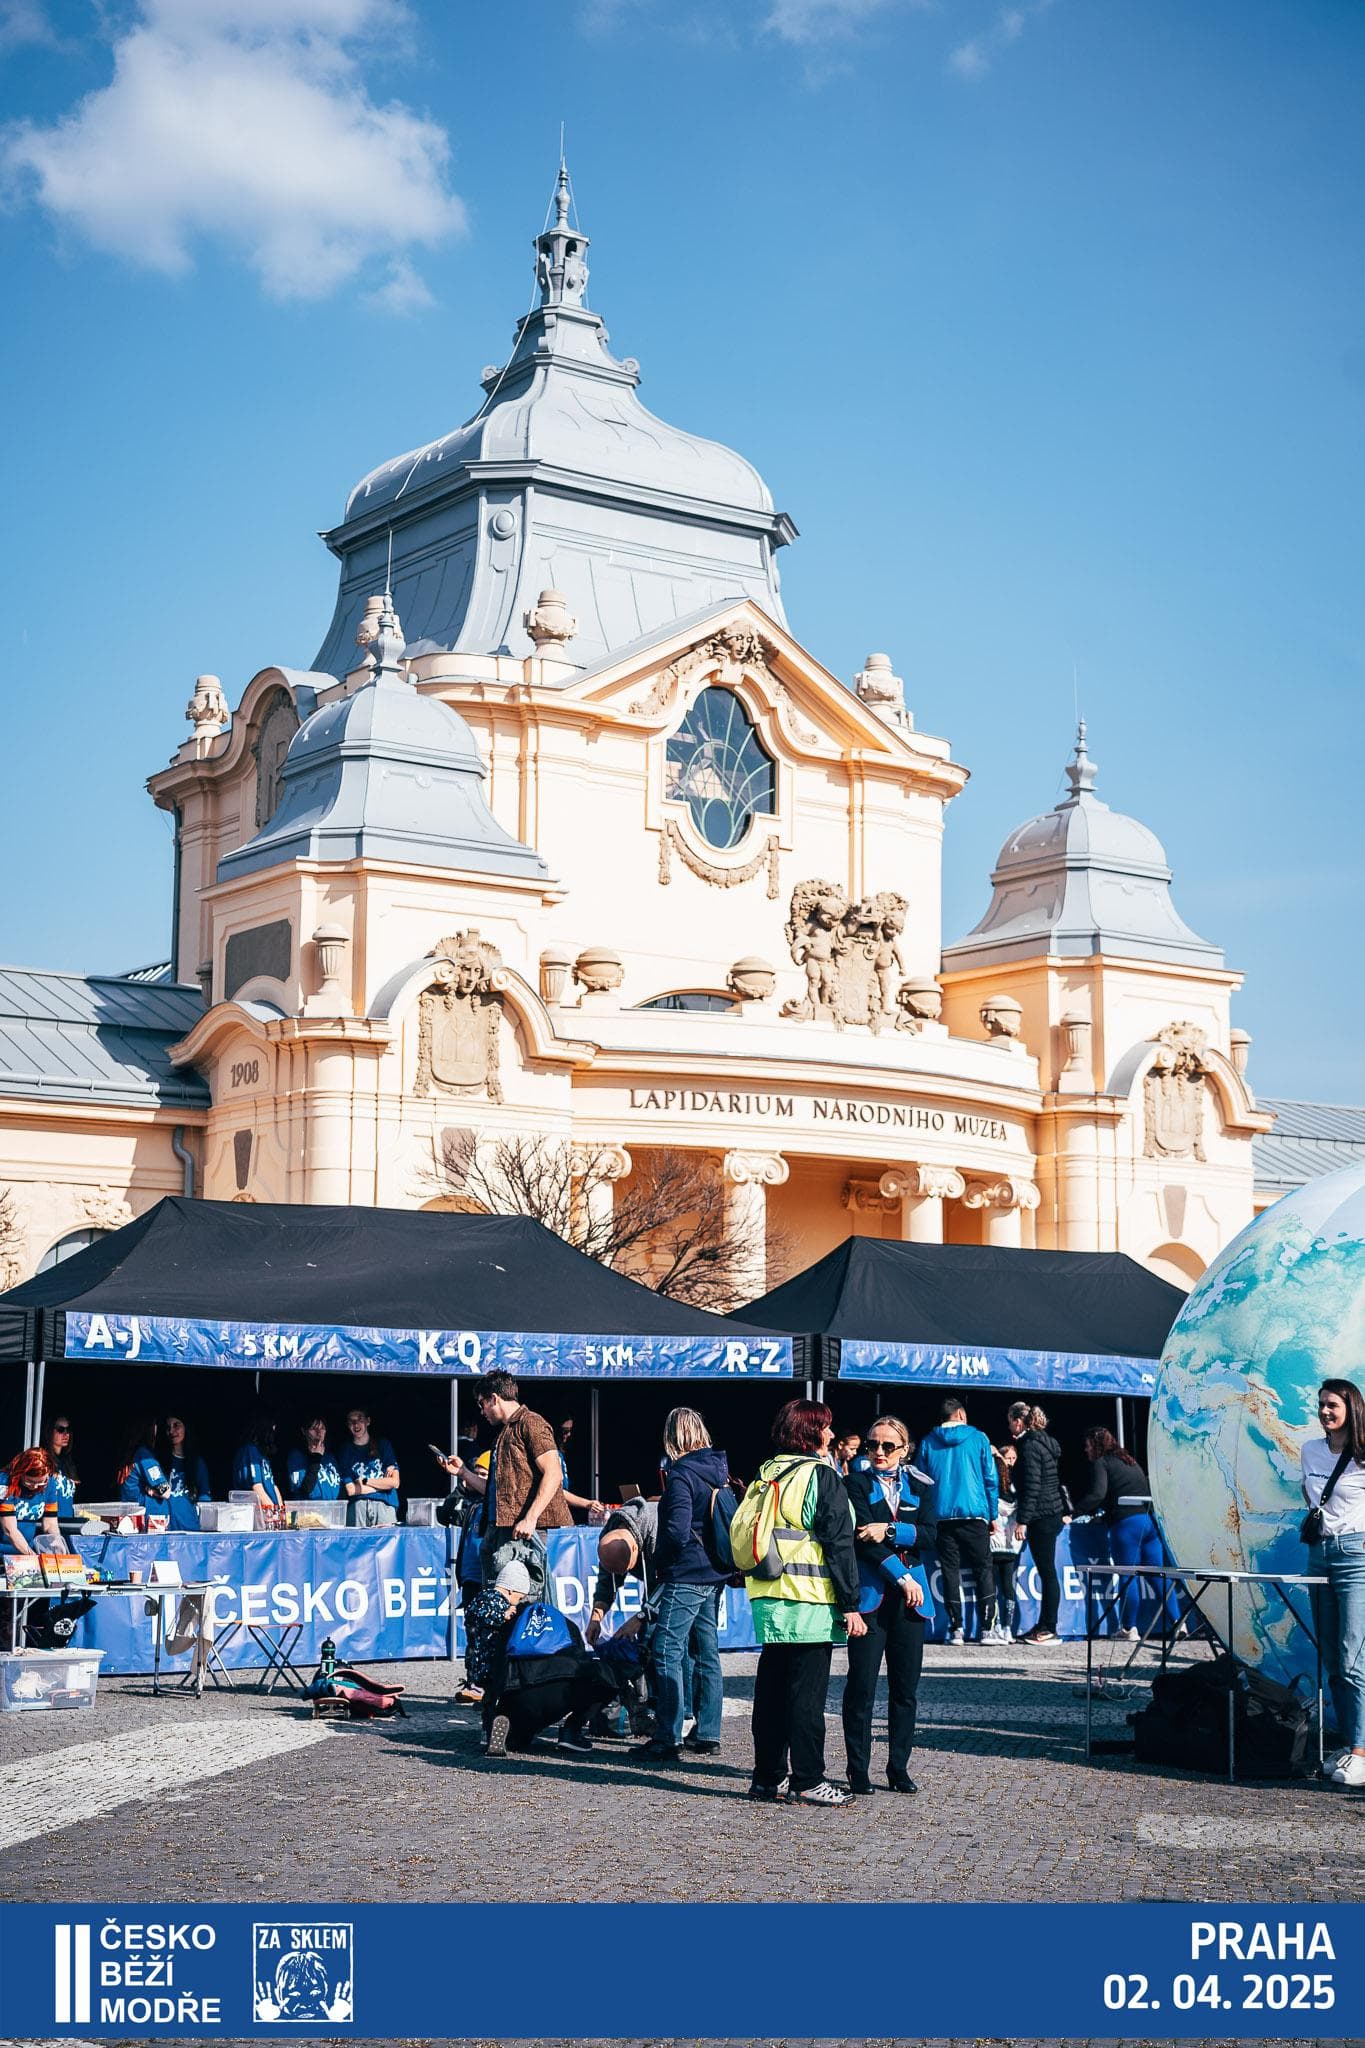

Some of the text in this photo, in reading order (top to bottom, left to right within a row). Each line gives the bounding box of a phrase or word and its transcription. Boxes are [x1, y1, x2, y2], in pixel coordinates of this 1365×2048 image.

[231, 1059, 259, 1088] 1908
[955, 1115, 1008, 1142] MUZEA
[84, 1314, 142, 1359] A-J
[418, 1331, 482, 1374] K-Q
[726, 1341, 781, 1374] R-Z
[211, 1574, 370, 1627] ČESKO
